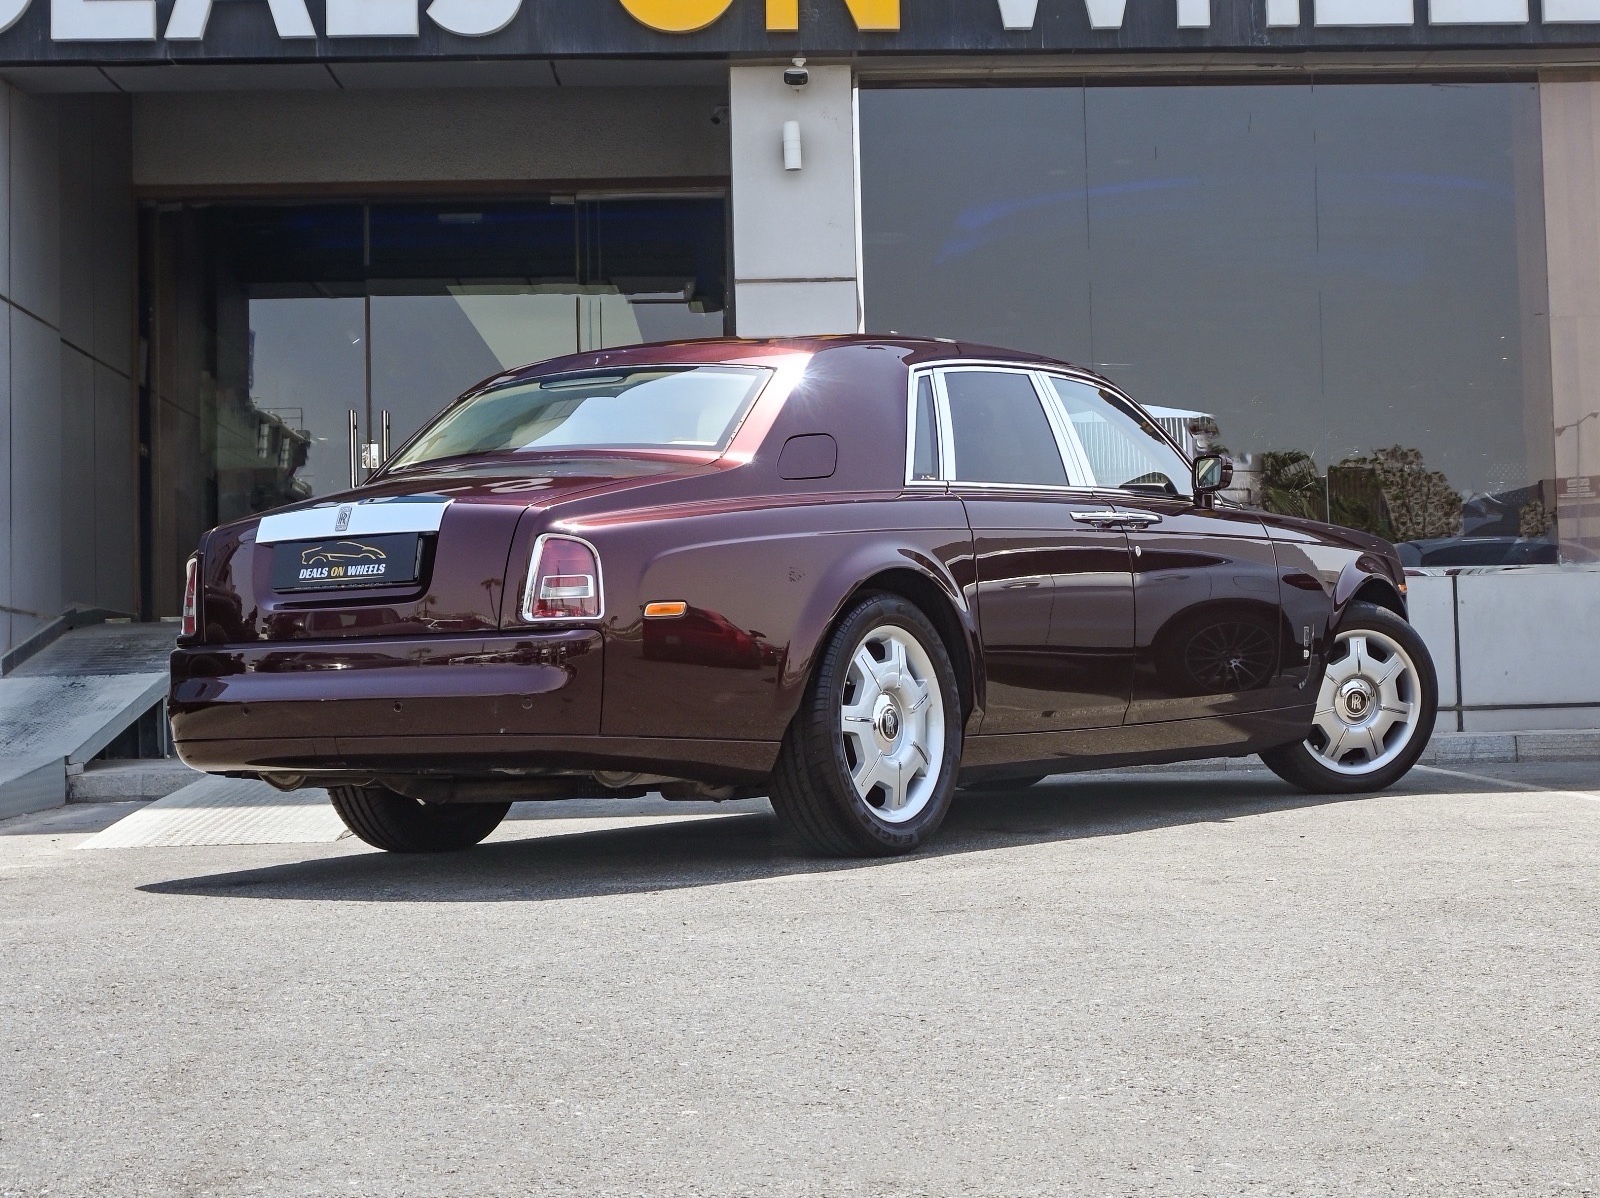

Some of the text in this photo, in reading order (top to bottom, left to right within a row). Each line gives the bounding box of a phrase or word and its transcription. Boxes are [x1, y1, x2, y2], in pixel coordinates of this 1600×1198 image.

[299, 563, 386, 579] DEALS ON WHEELS
